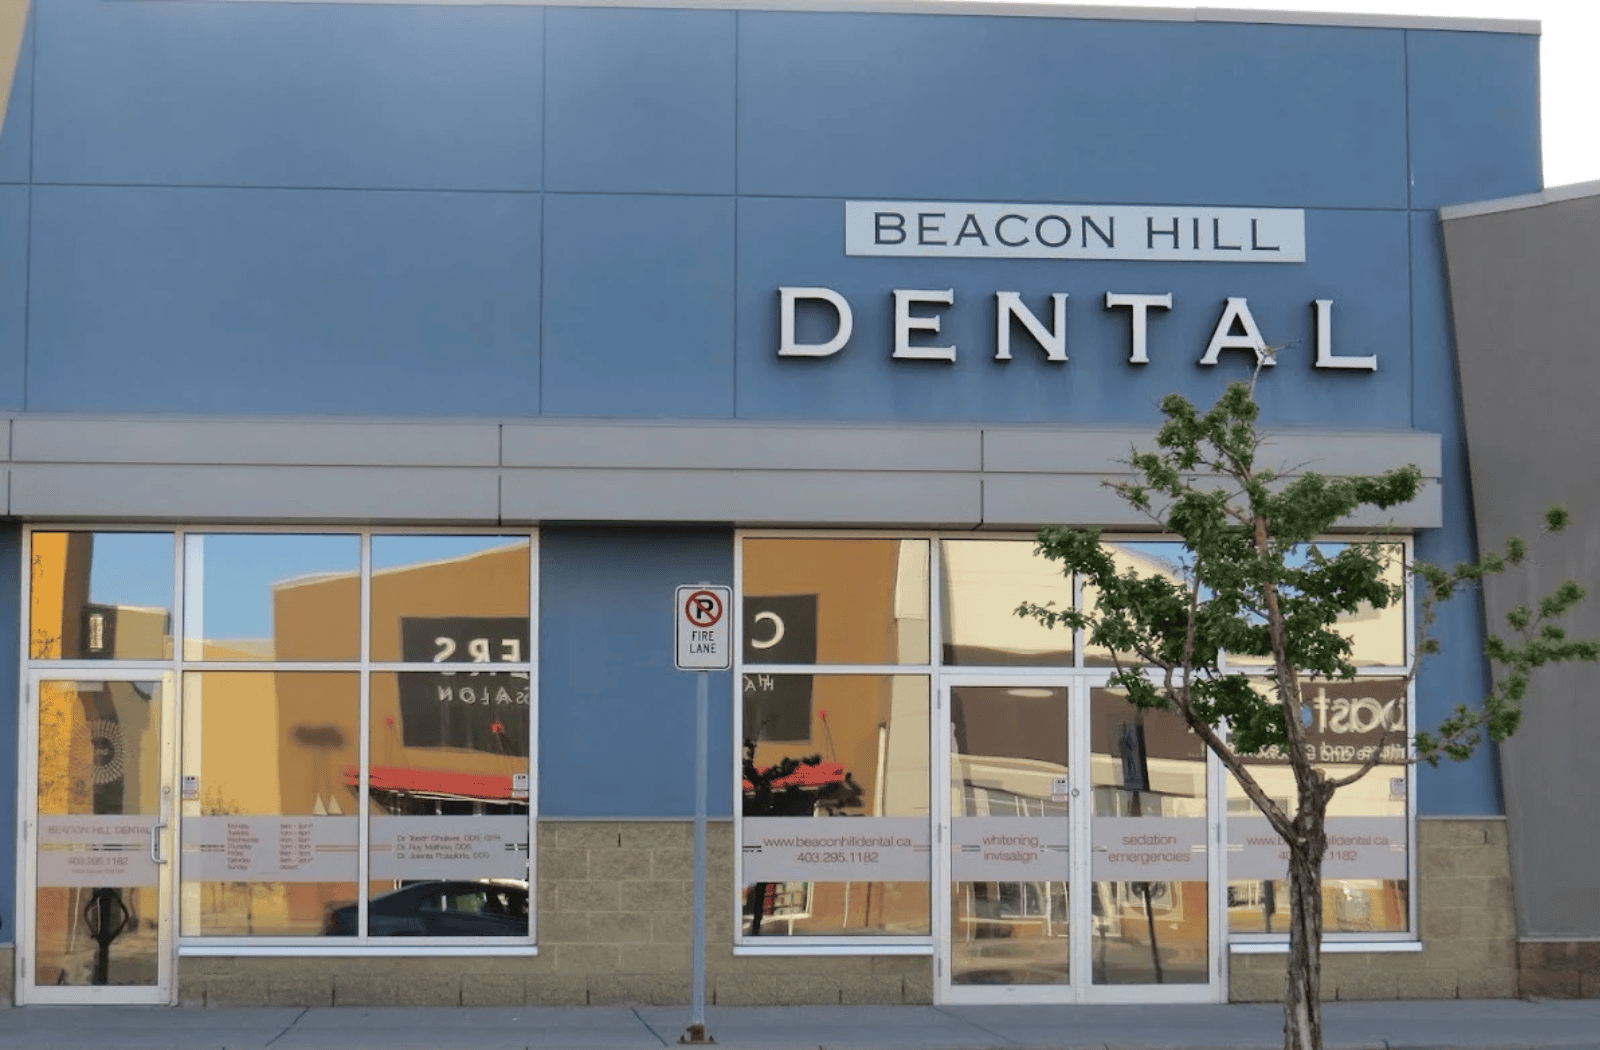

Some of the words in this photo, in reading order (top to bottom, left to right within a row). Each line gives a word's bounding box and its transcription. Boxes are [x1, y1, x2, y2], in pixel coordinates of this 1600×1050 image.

[873, 211, 1114, 249] BEACON
[1147, 216, 1280, 252] HILL
[777, 285, 1378, 371] DENTAL
[691, 630, 715, 642] FIRE
[689, 643, 717, 654] LANE
[763, 835, 912, 848] www.beaconhilldental.ca
[982, 835, 1039, 848] whitening
[1122, 834, 1177, 846] sedation
[797, 851, 879, 863] 403.295.1182
[983, 850, 1038, 864] invisalign
[1108, 851, 1191, 864] emergencies
